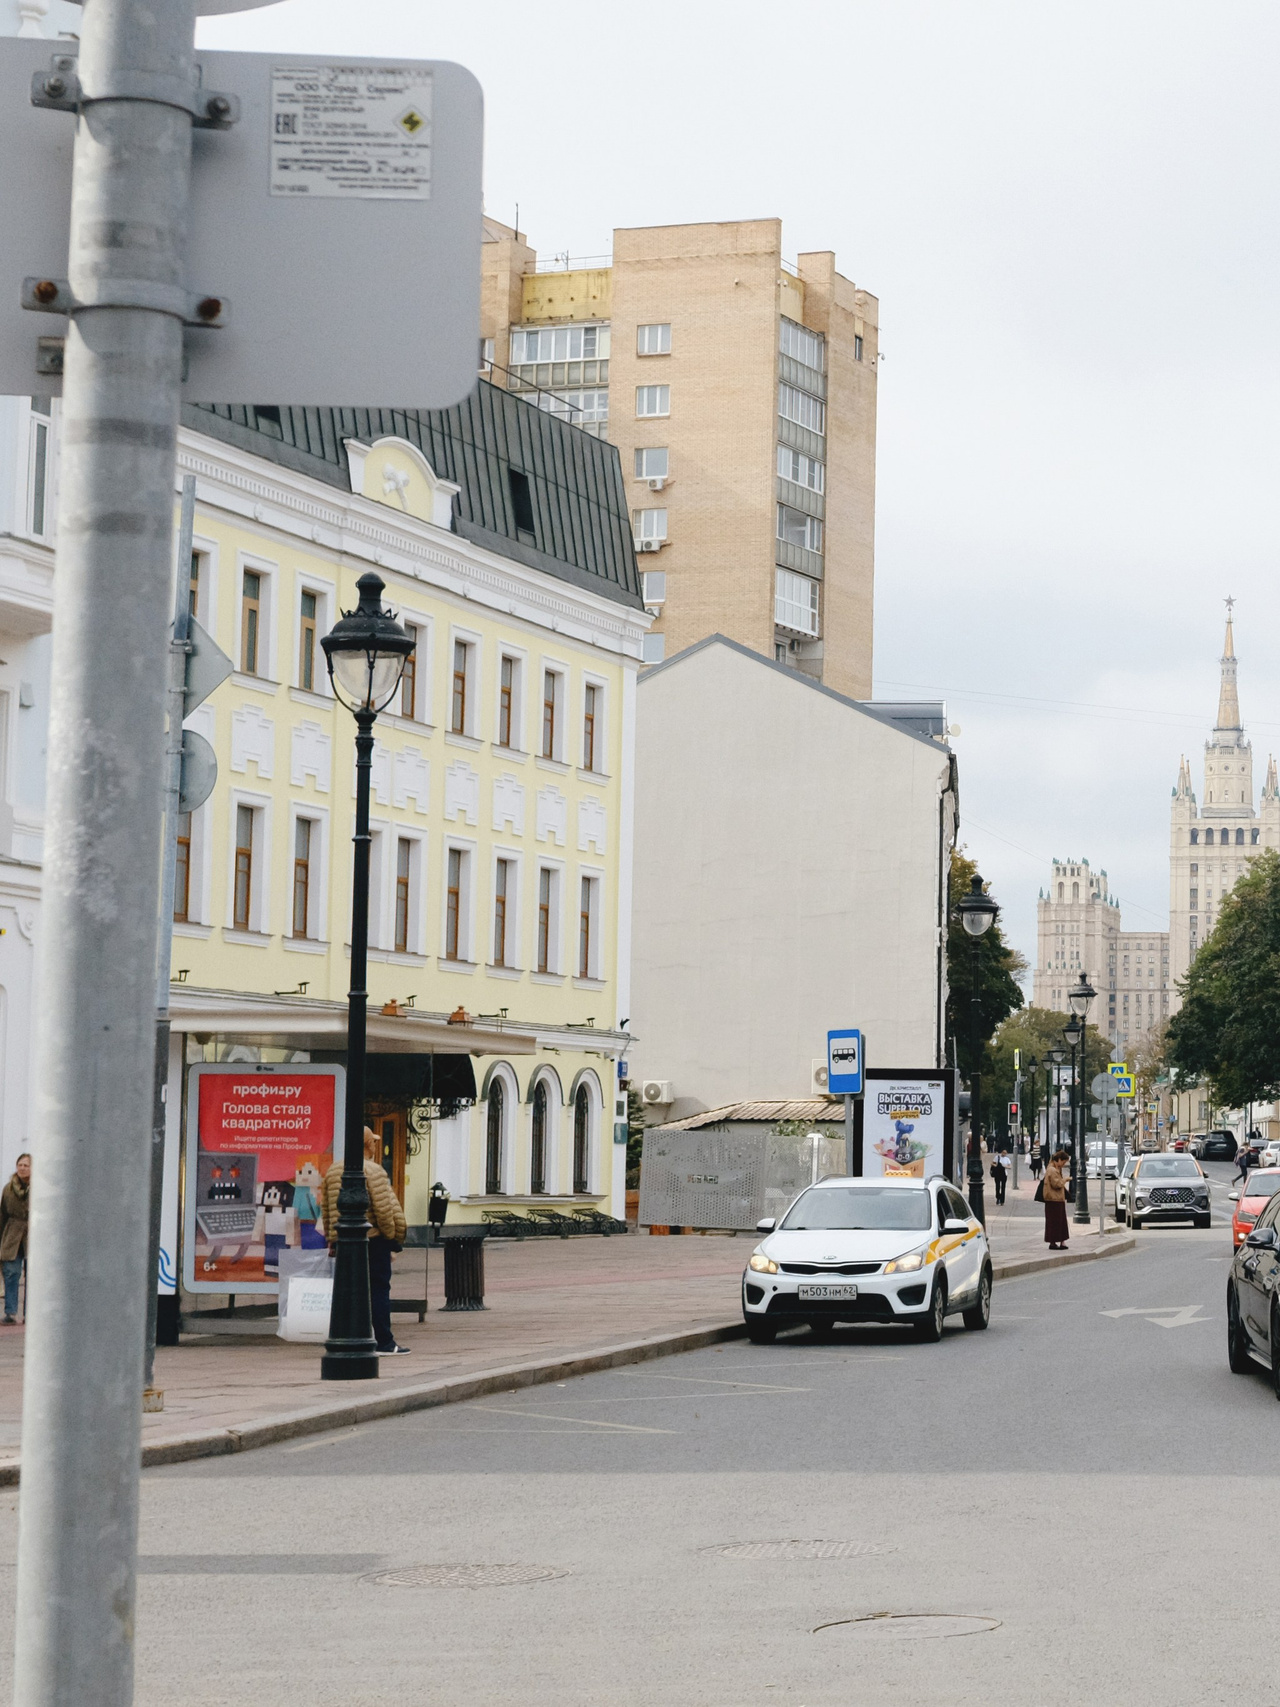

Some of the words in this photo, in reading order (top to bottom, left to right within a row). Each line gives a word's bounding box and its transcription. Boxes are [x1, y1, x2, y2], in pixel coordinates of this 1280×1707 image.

[295, 83, 319, 92] ООО
[878, 1093, 932, 1105] ВЫСТАВКА
[222, 1102, 270, 1115] Голова
[272, 1105, 312, 1115] стала
[878, 1104, 906, 1115] SUPER
[908, 1104, 932, 1115] TOYS
[222, 1117, 312, 1131] квадратной?
[229, 1142, 272, 1150] информатике
[282, 1143, 312, 1151] Профи.ру
[203, 1261, 217, 1271] 6+
